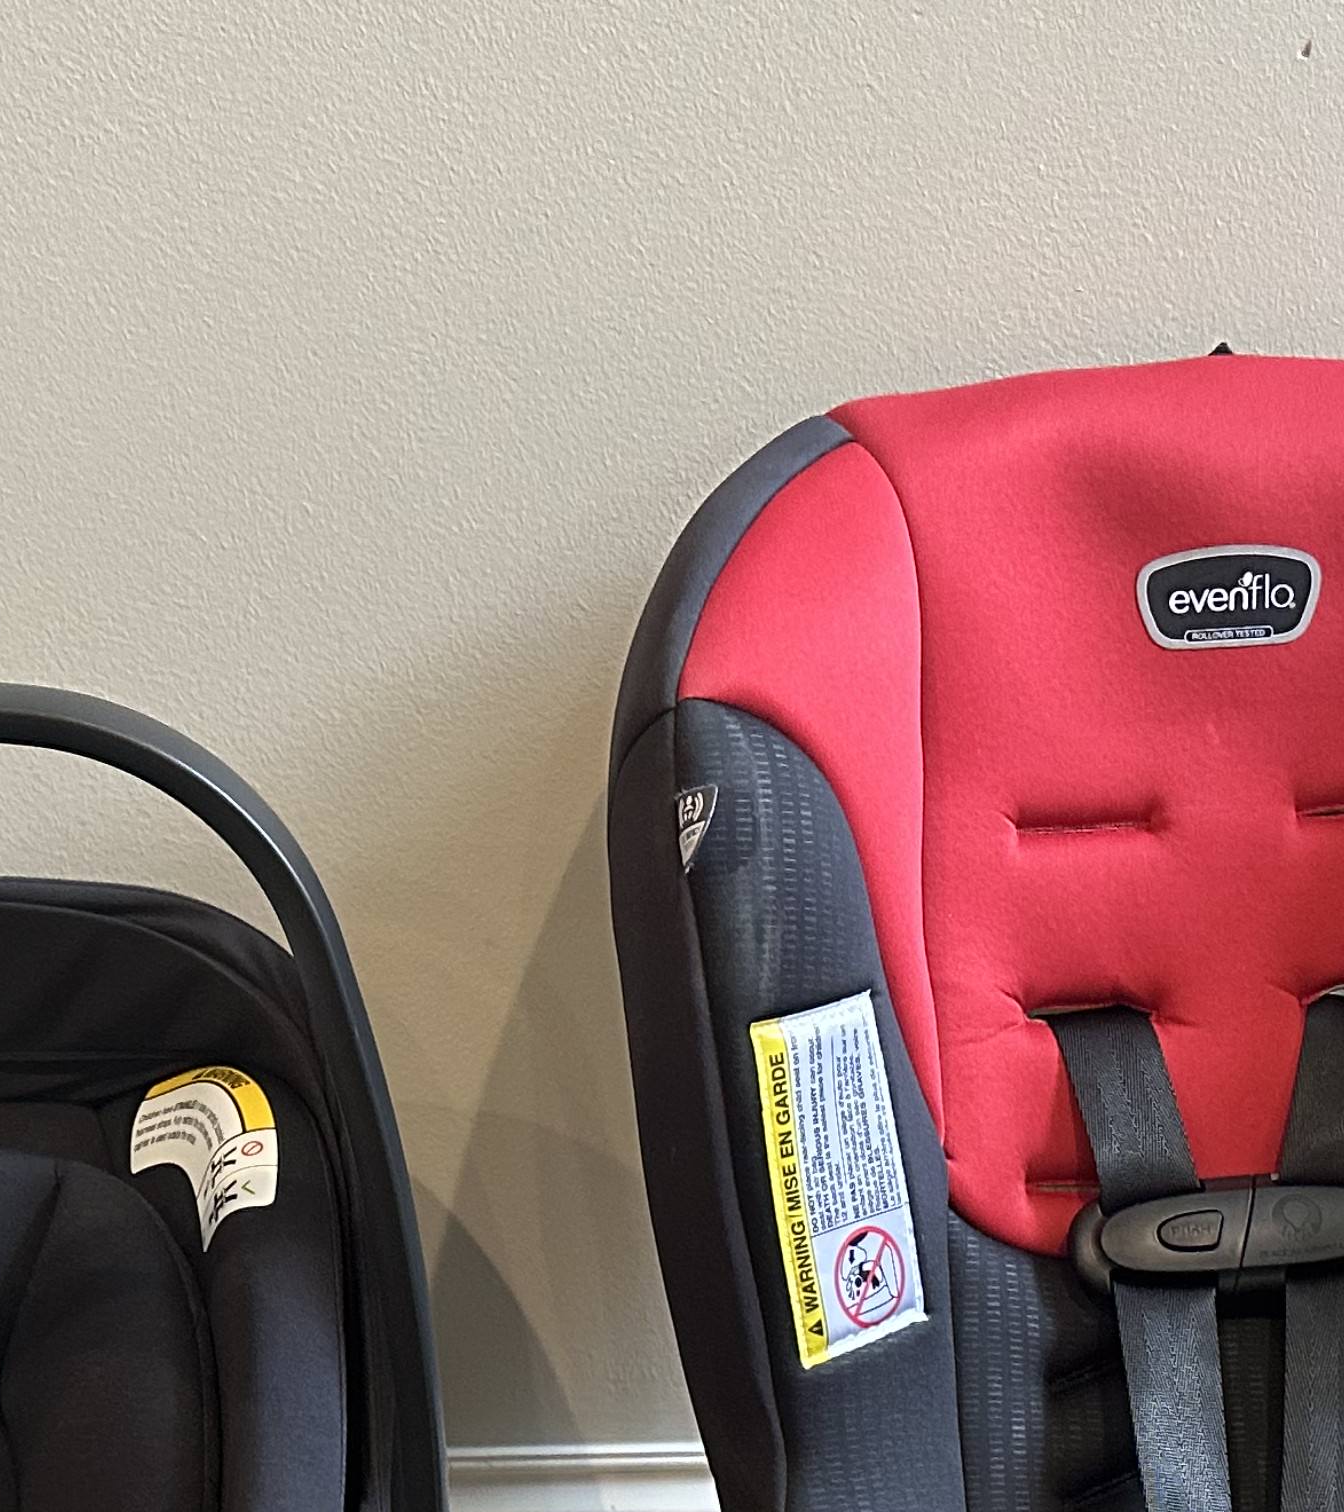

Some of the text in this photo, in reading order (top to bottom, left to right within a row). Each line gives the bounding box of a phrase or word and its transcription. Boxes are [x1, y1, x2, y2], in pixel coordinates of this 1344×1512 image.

[1168, 571, 1296, 614] evenflo
[1191, 628, 1266, 640] ROLLOVER TESTED
[769, 1052, 790, 1125] GARDE
[778, 1130, 794, 1159] EN
[782, 1163, 801, 1211] MISE
[791, 1221, 818, 1313] WARNING
